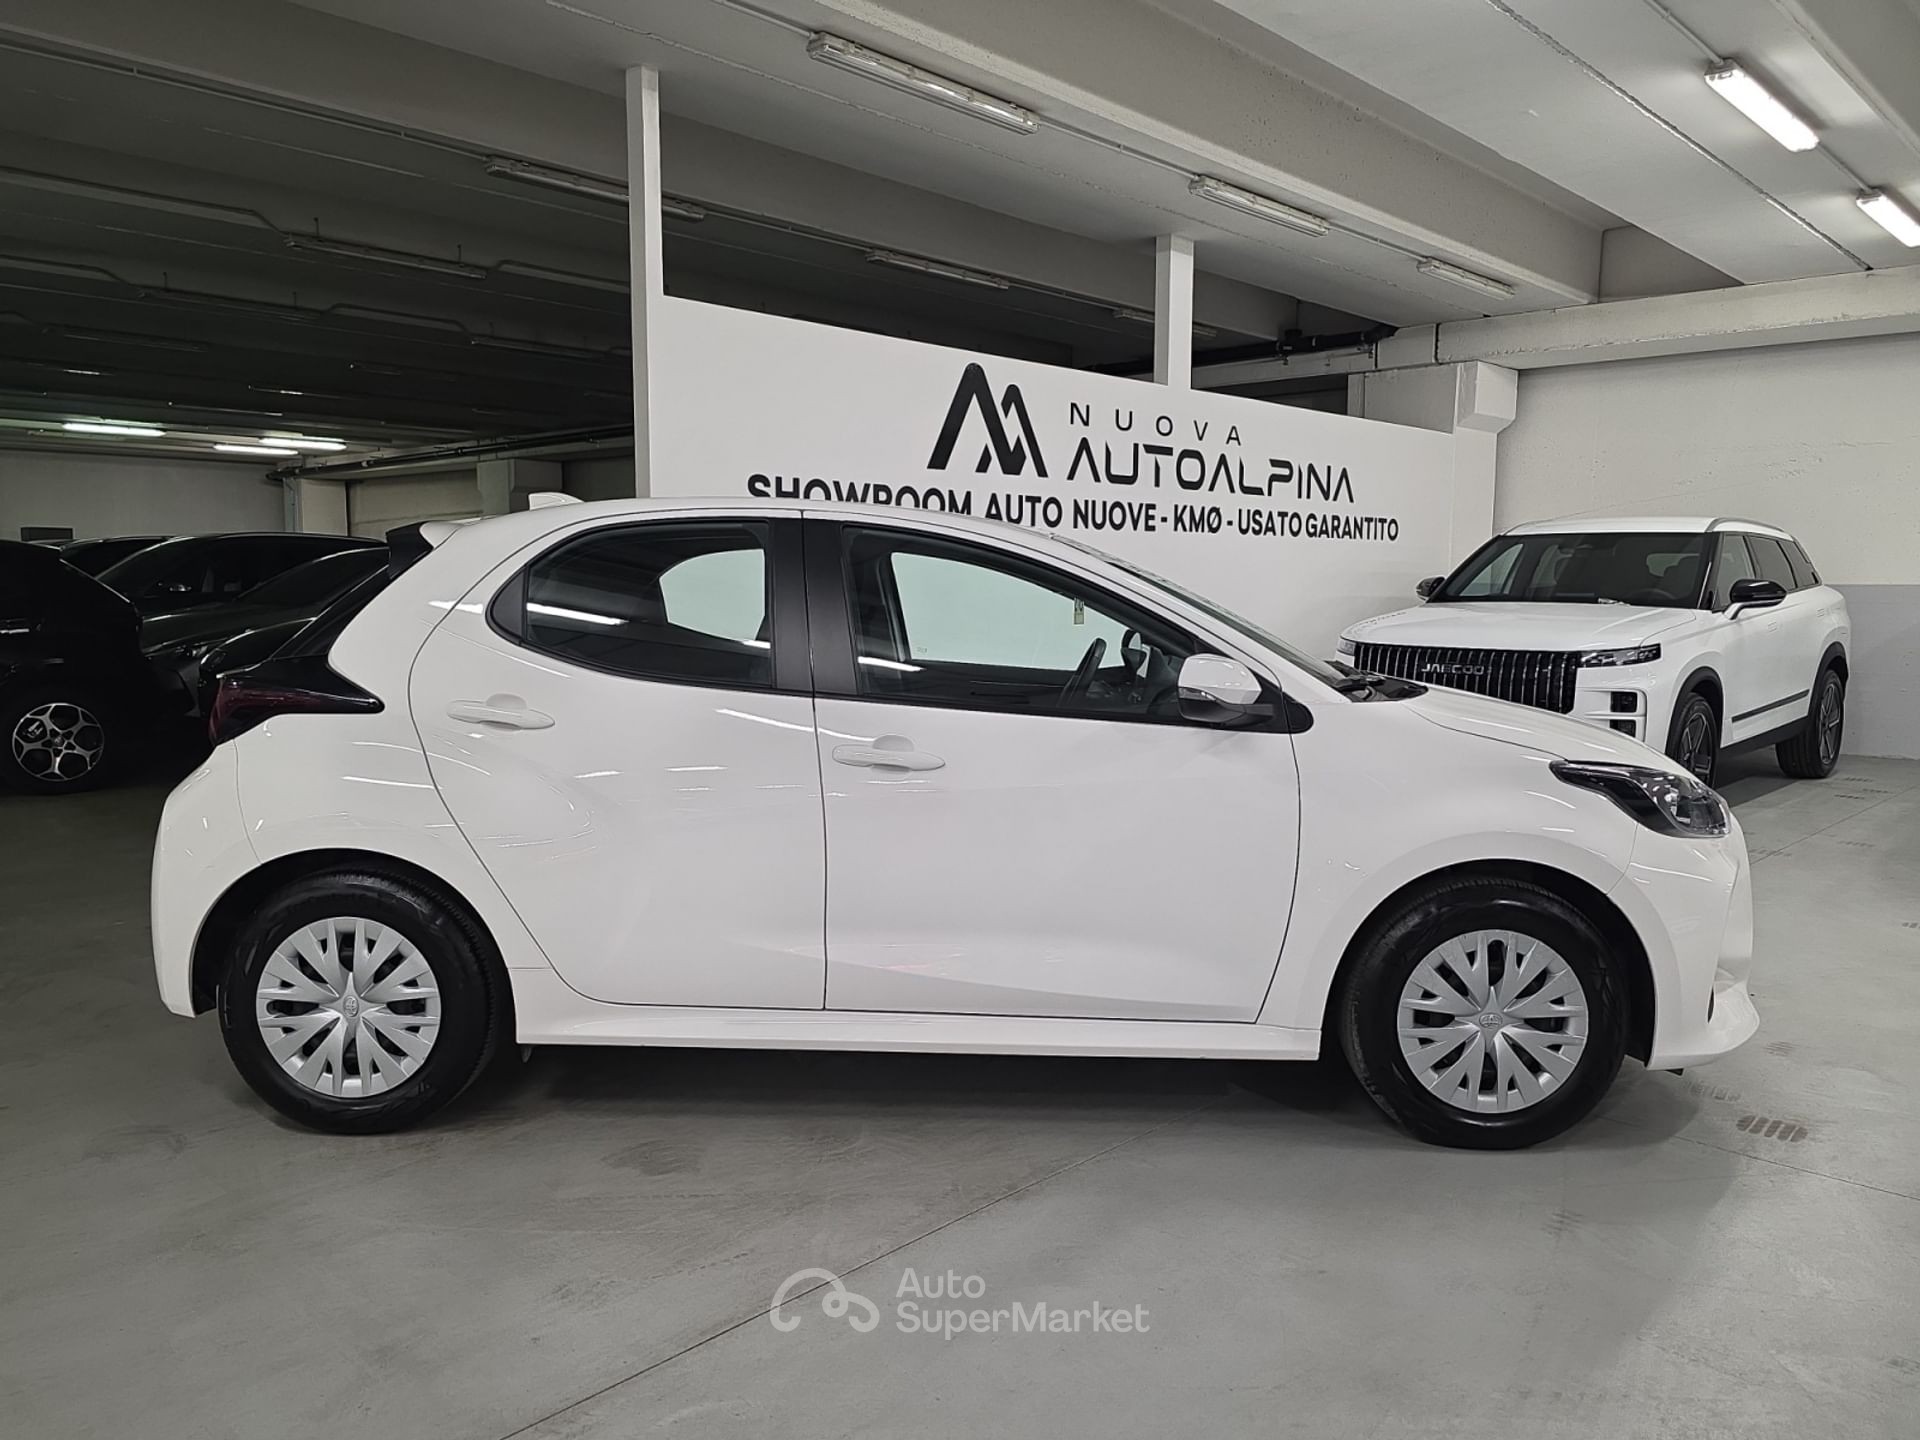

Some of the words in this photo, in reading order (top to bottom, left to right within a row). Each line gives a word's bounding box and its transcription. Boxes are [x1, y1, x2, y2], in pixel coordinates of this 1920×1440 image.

[1069, 402, 1241, 446] NUOVA
[1066, 437, 1354, 503] AUTOALPINA
[747, 474, 972, 515] SHOWROOM
[985, 493, 1063, 528] AUTO
[1073, 499, 1157, 531] NUOVE
[1238, 508, 1301, 538] USATO
[1305, 513, 1399, 541] GARANTITO
